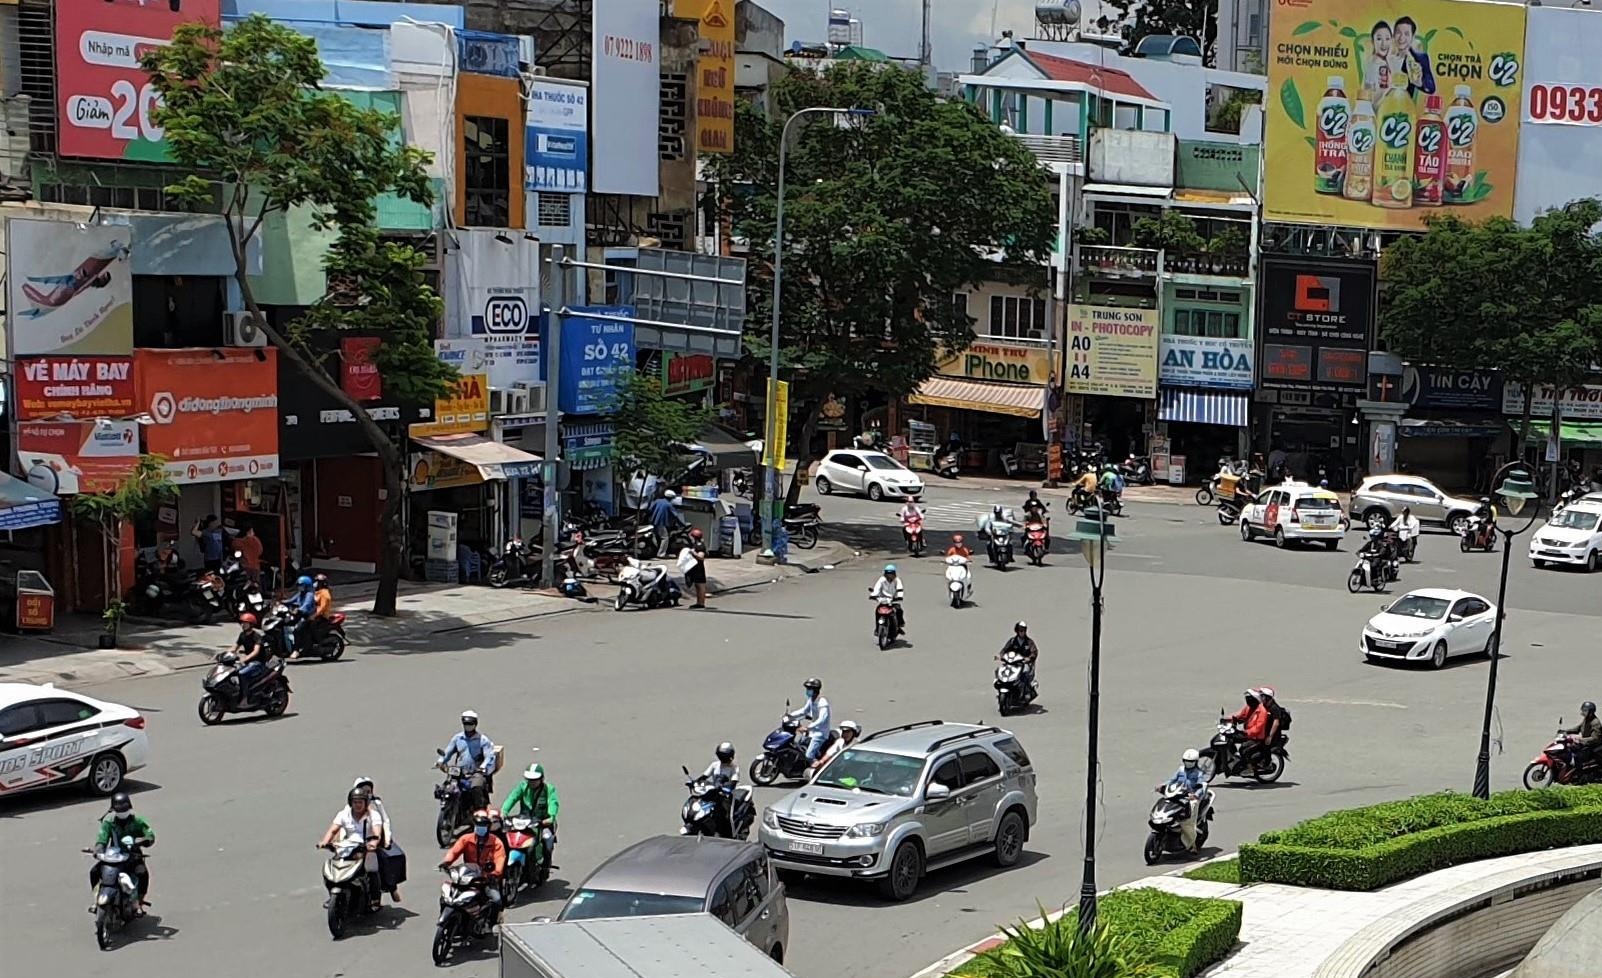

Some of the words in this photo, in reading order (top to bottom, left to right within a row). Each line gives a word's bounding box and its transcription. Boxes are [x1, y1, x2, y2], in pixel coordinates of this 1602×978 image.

[1277, 43, 1312, 57] CHỌN
[1437, 53, 1462, 65] CHỌN
[1436, 64, 1482, 82] CHỌN
[1488, 55, 1520, 87] C2
[76, 97, 110, 121] Giảm
[1320, 107, 1349, 137] C2
[1380, 116, 1412, 148] C2
[1447, 117, 1475, 145] C2
[1352, 130, 1373, 152] C2
[1418, 126, 1442, 152] C2
[492, 303, 522, 327] ECO
[1092, 310, 1121, 321] TRUNG
[1306, 314, 1347, 324] STORE
[1071, 321, 1082, 332] IN
[1092, 322, 1154, 336] PHOTOCOPY
[611, 342, 629, 360] 42
[1071, 336, 1091, 351] A0
[964, 353, 1030, 381] iPhone
[1162, 348, 1196, 368] AN
[52, 358, 90, 381] MÁY
[96, 362, 130, 380] BAY
[1071, 364, 1090, 379] A4
[28, 739, 85, 768] SPORT
